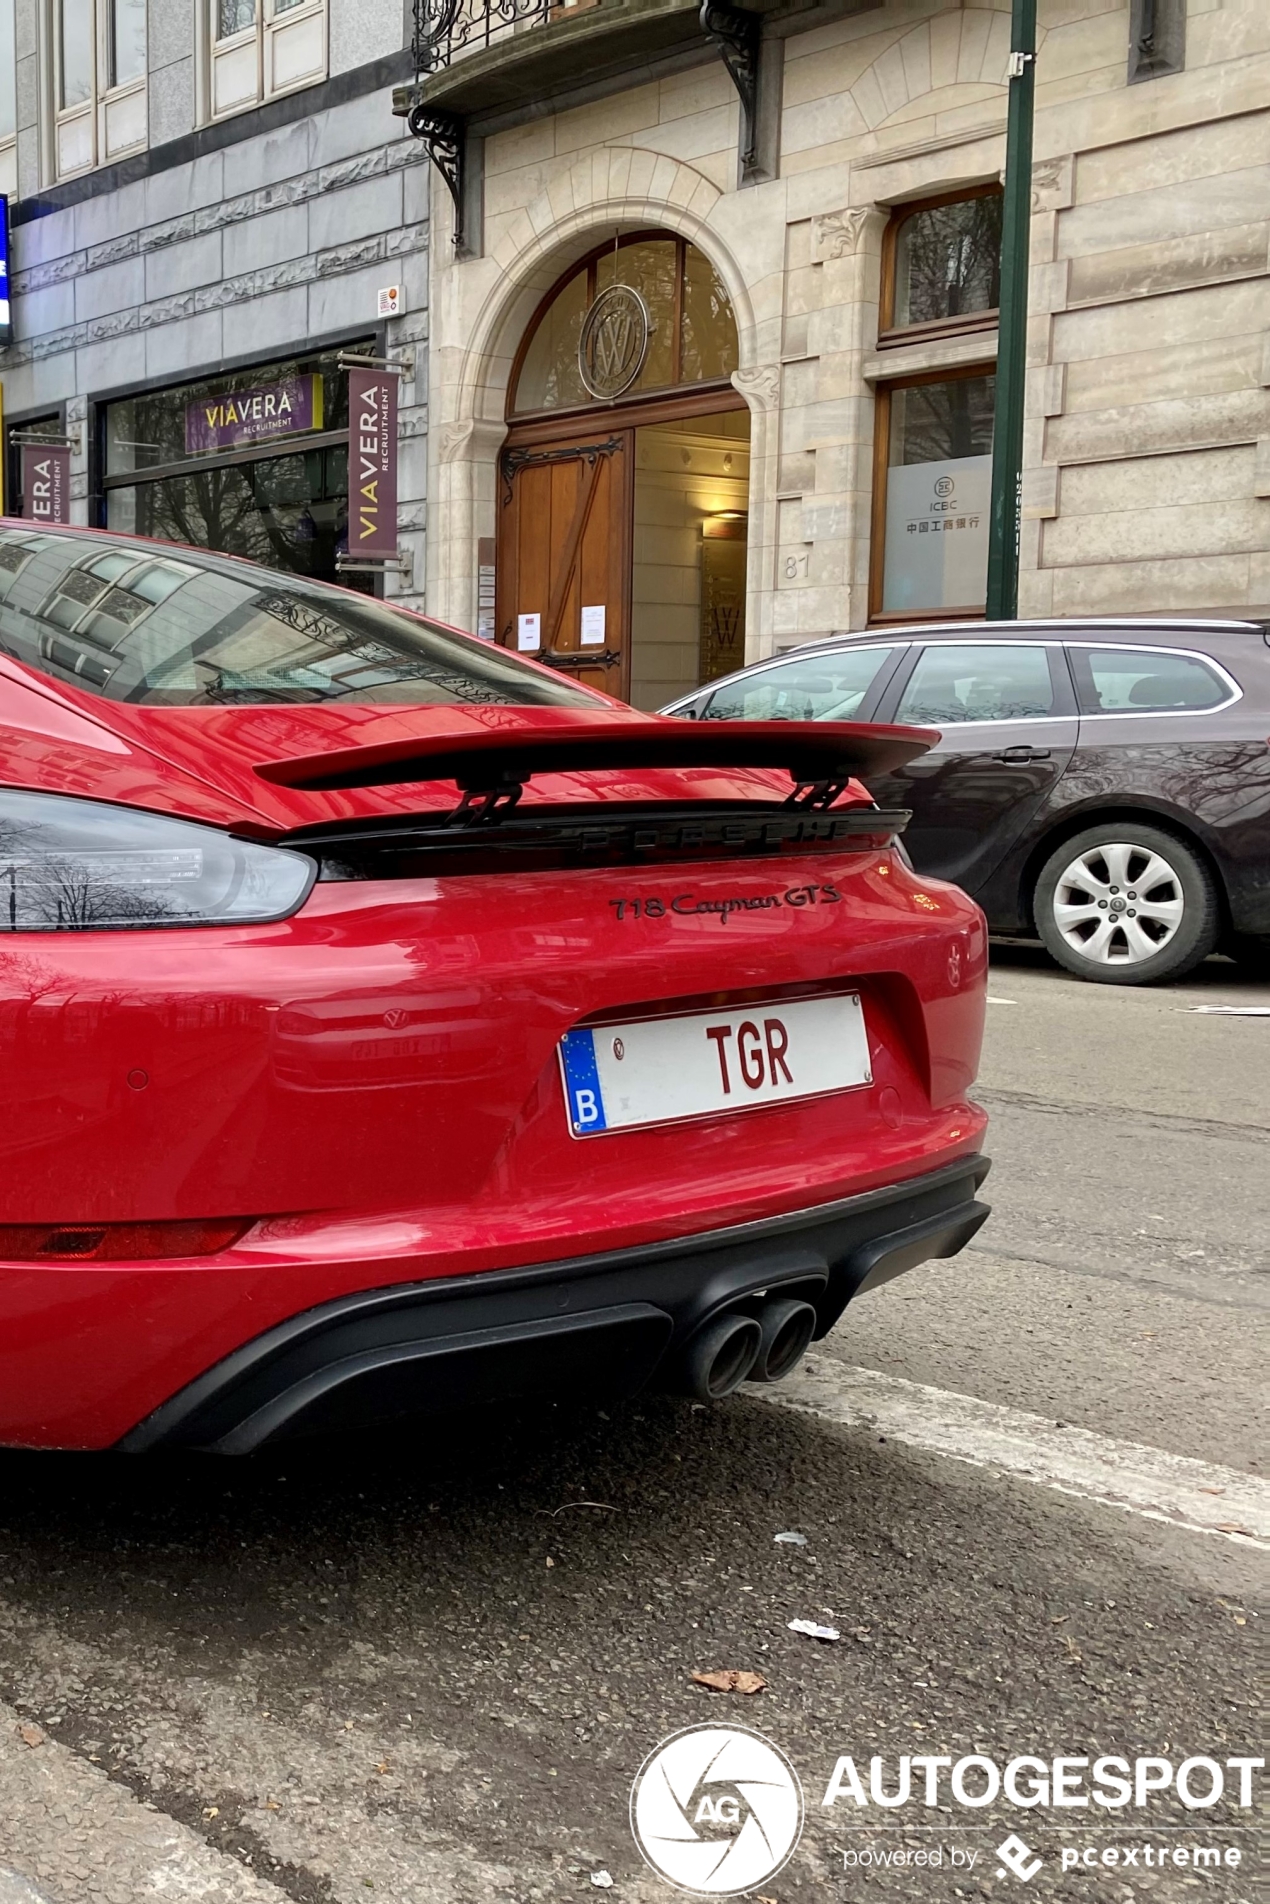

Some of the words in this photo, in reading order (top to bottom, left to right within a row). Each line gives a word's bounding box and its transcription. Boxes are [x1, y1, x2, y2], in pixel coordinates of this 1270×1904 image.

[205, 391, 292, 428] VIAVERA
[243, 417, 292, 434] RECRUITMENT
[381, 386, 389, 472] RECRUITMENT
[359, 385, 379, 540] VIAVERA
[33, 459, 51, 520] ERA
[930, 500, 957, 512] ICBC
[785, 554, 810, 579] 81
[580, 820, 850, 851] PORSCHE
[610, 896, 666, 920] 718
[672, 894, 781, 925] Cayman
[785, 883, 843, 905] GTS
[705, 1018, 794, 1094] TGR
[575, 1089, 599, 1123] B
